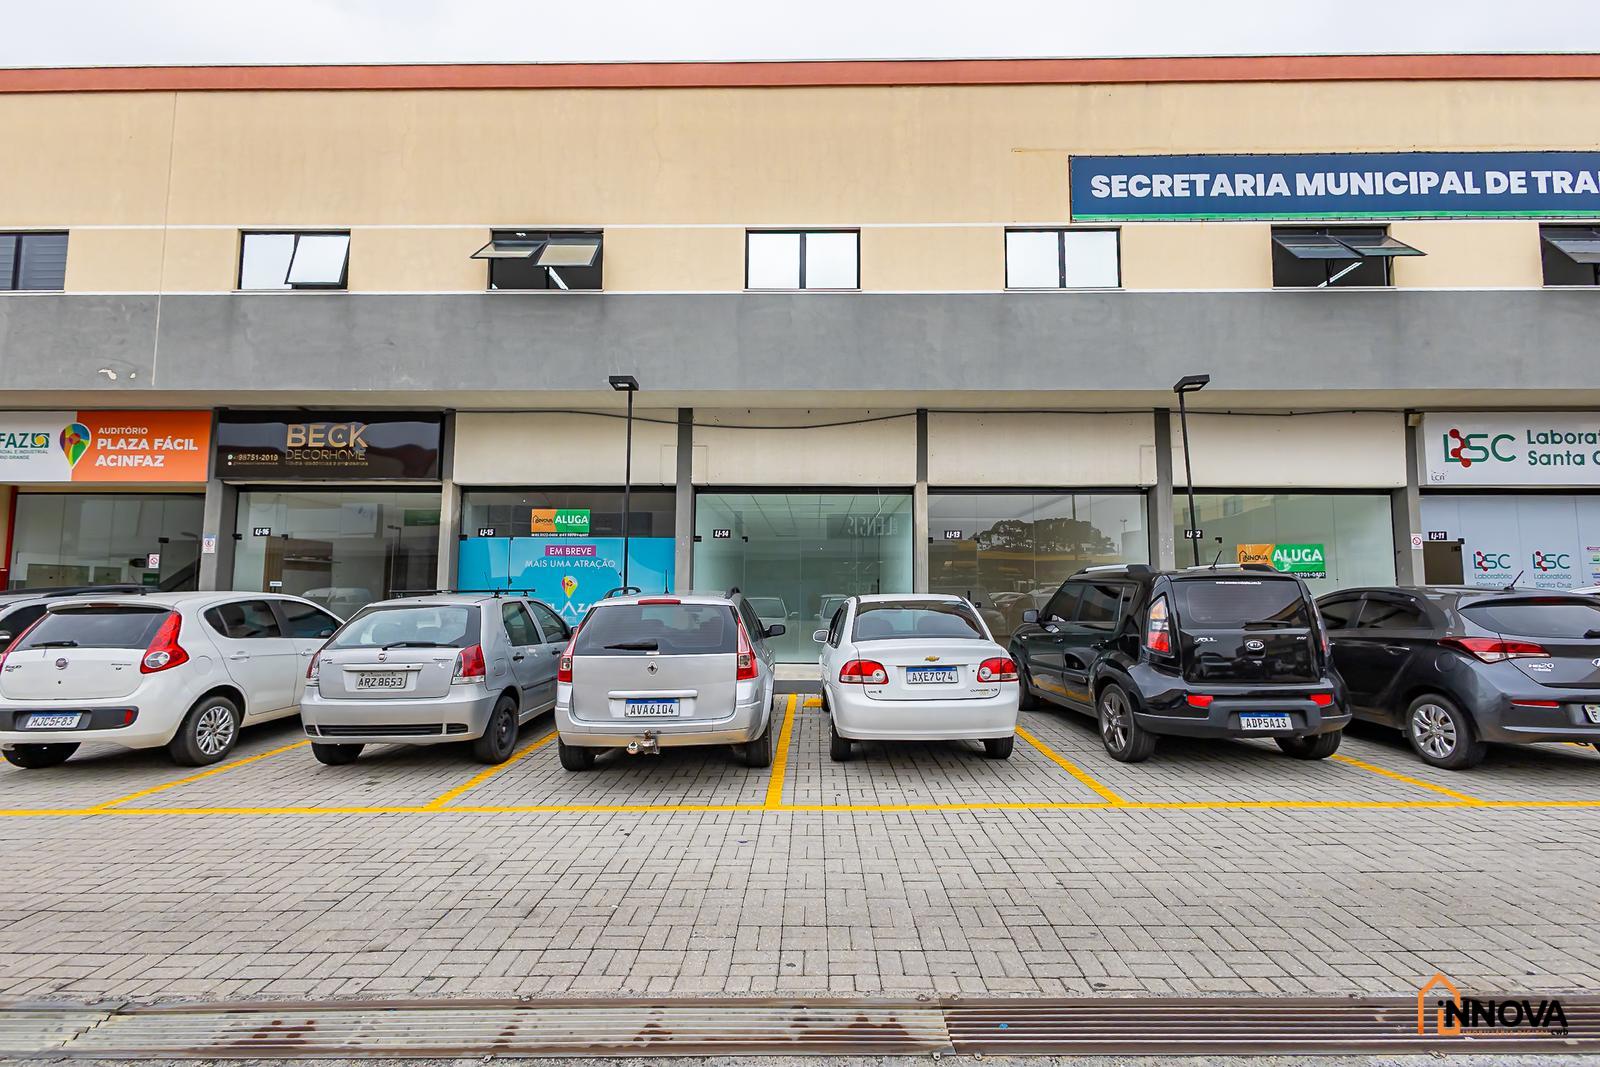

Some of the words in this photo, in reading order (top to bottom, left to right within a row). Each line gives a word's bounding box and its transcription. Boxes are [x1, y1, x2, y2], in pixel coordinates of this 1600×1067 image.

[1091, 173, 1291, 198] SECRETARIA
[1296, 171, 1481, 196] MUNICIPAL
[1485, 171, 1528, 194] DE
[1531, 170, 1600, 194] TRA
[98, 426, 149, 435] AUDITÓRIO
[286, 424, 369, 448] BECK
[97, 438, 150, 450] PLAZA
[153, 436, 199, 450] FÁCIL
[1527, 429, 1600, 445] Labora
[95, 455, 165, 467] ACINFAZ
[285, 449, 366, 461] DECORHOME
[1527, 450, 1585, 466] Santa
[555, 515, 589, 524] ALUGA
[549, 547, 563, 555] EM
[565, 547, 592, 555] BREVE
[1273, 549, 1323, 562] ALUGA
[526, 560, 548, 568] MAIS
[550, 560, 572, 568] UMA
[573, 558, 616, 569] ATRAÇÃO
[358, 678, 378, 687] ARZ
[379, 678, 403, 687] 8653
[912, 671, 954, 682] AXE7C74
